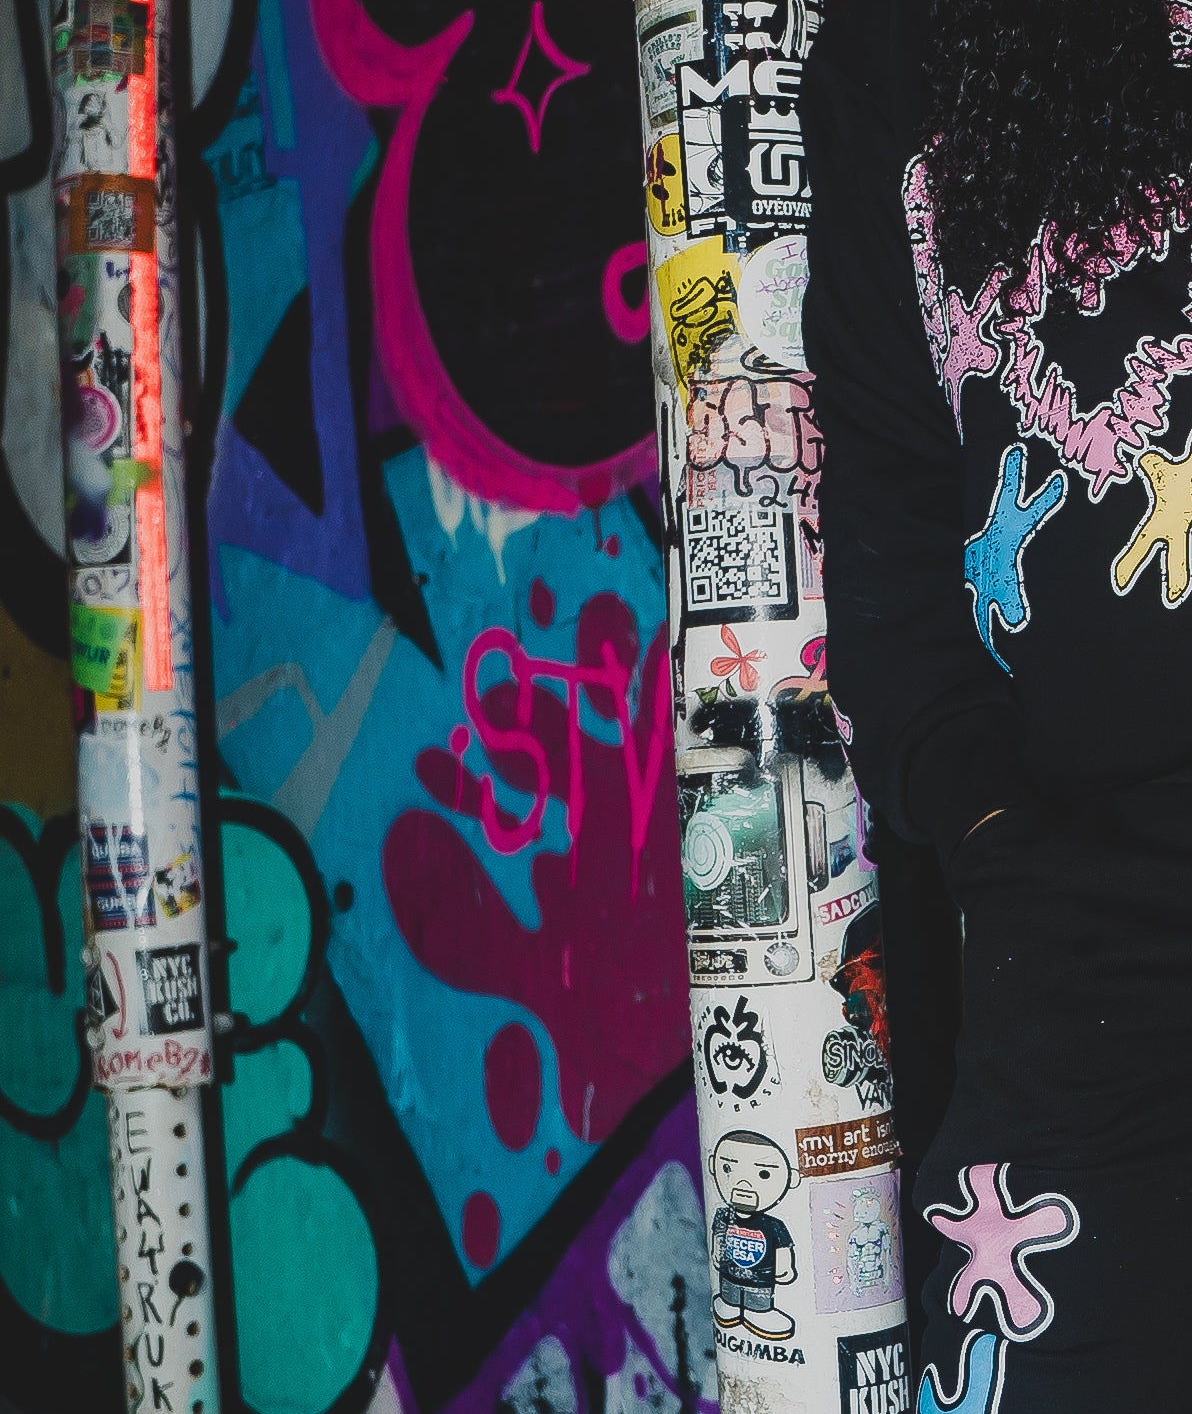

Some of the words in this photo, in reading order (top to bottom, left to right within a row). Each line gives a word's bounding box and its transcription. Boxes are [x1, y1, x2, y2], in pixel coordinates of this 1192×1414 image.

[800, 1134, 834, 1153] my
[843, 1124, 871, 1147] art
[803, 1147, 858, 1170] horny
[855, 1342, 906, 1387] NYC
